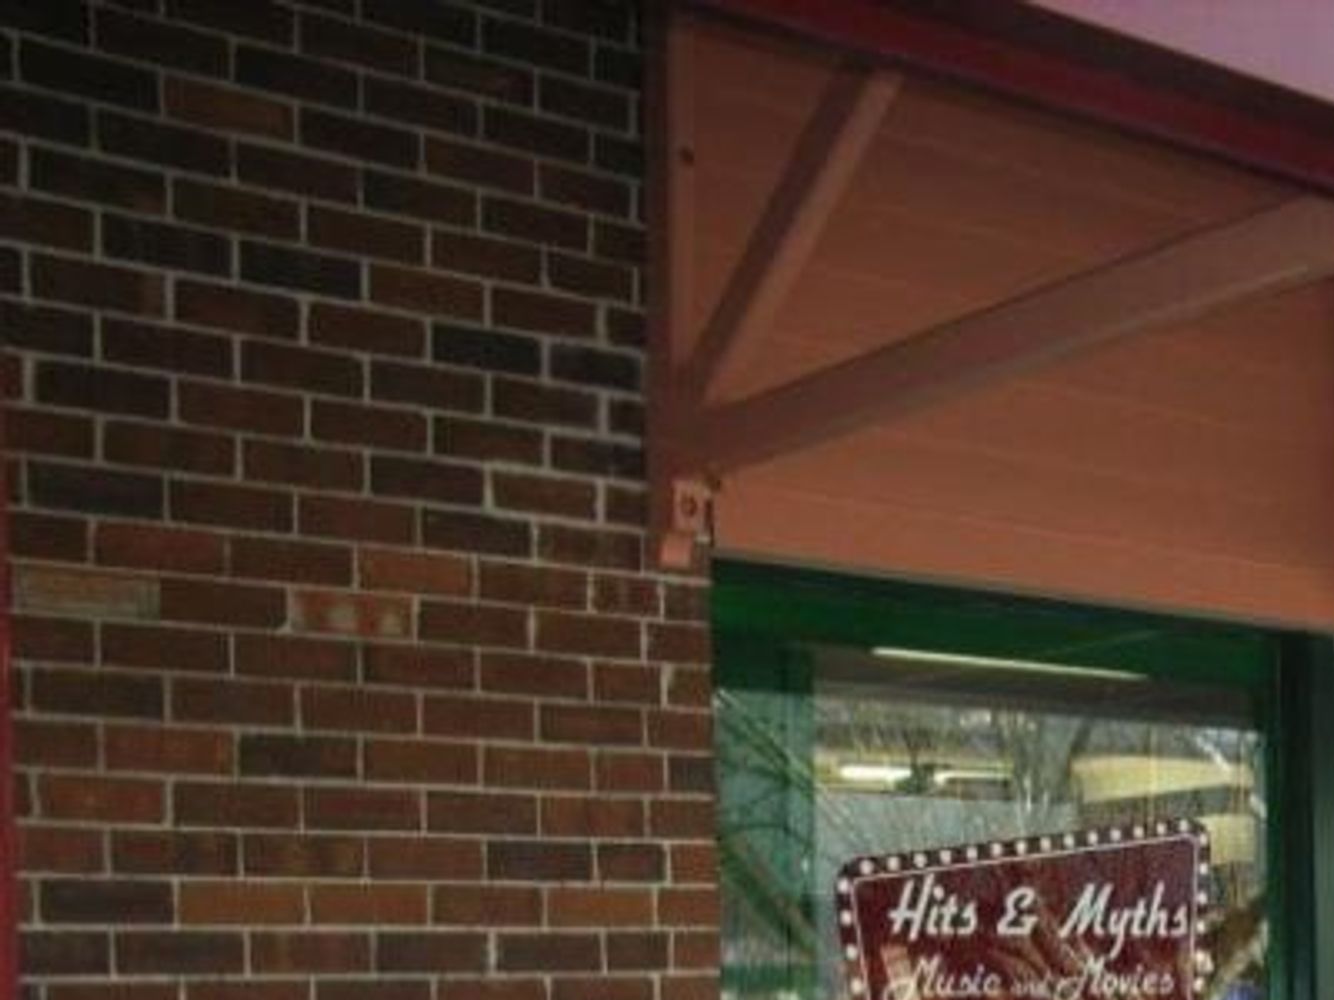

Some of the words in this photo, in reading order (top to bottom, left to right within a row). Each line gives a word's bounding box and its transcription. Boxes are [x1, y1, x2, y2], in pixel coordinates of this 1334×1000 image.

[888, 874, 979, 941] Hits
[997, 886, 1039, 936] &
[1059, 882, 1189, 965] Myths
